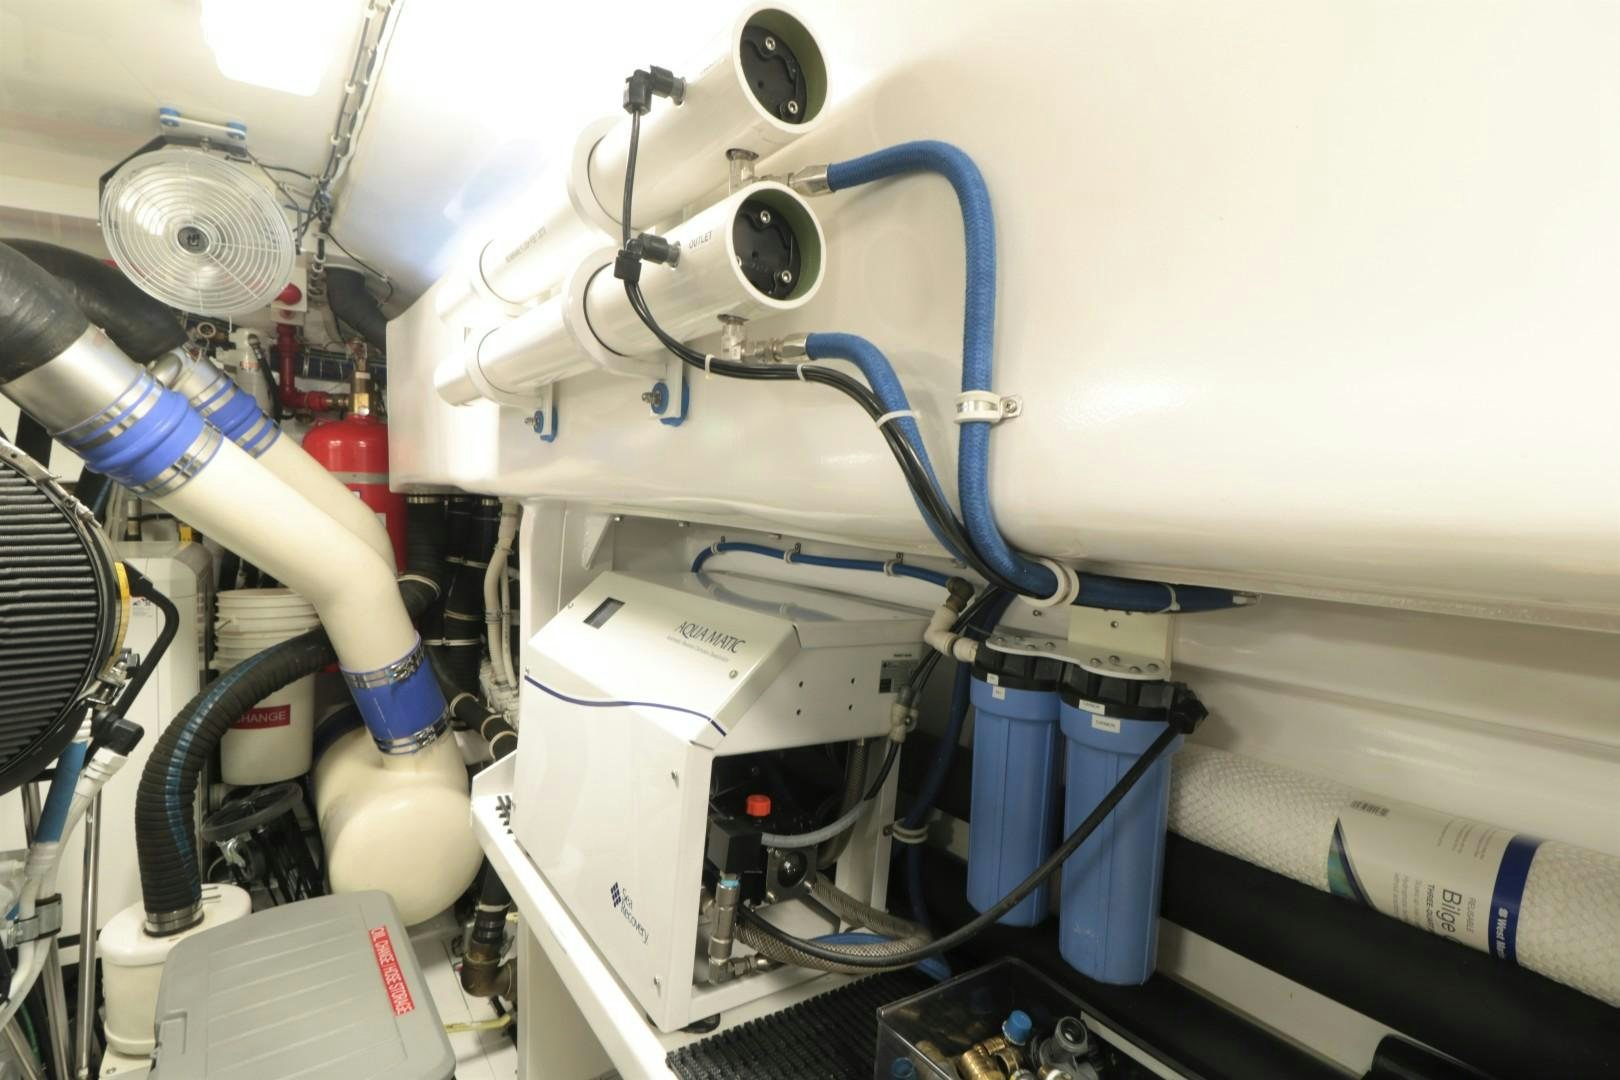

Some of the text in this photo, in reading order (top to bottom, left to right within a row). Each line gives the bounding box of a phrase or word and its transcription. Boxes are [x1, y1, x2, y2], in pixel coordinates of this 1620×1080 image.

[689, 231, 712, 249] OUTLET
[674, 621, 709, 641] AQUA
[709, 631, 746, 654] MATIC
[235, 710, 287, 723] HANGE
[621, 888, 649, 945] Sea Recovery
[1436, 889, 1463, 933] Bilge
[371, 927, 386, 942] OIL
[1495, 918, 1508, 940] West
[374, 941, 394, 965] CHANGE
[384, 967, 402, 985] HOSE
[389, 983, 412, 1015] STORAGE
